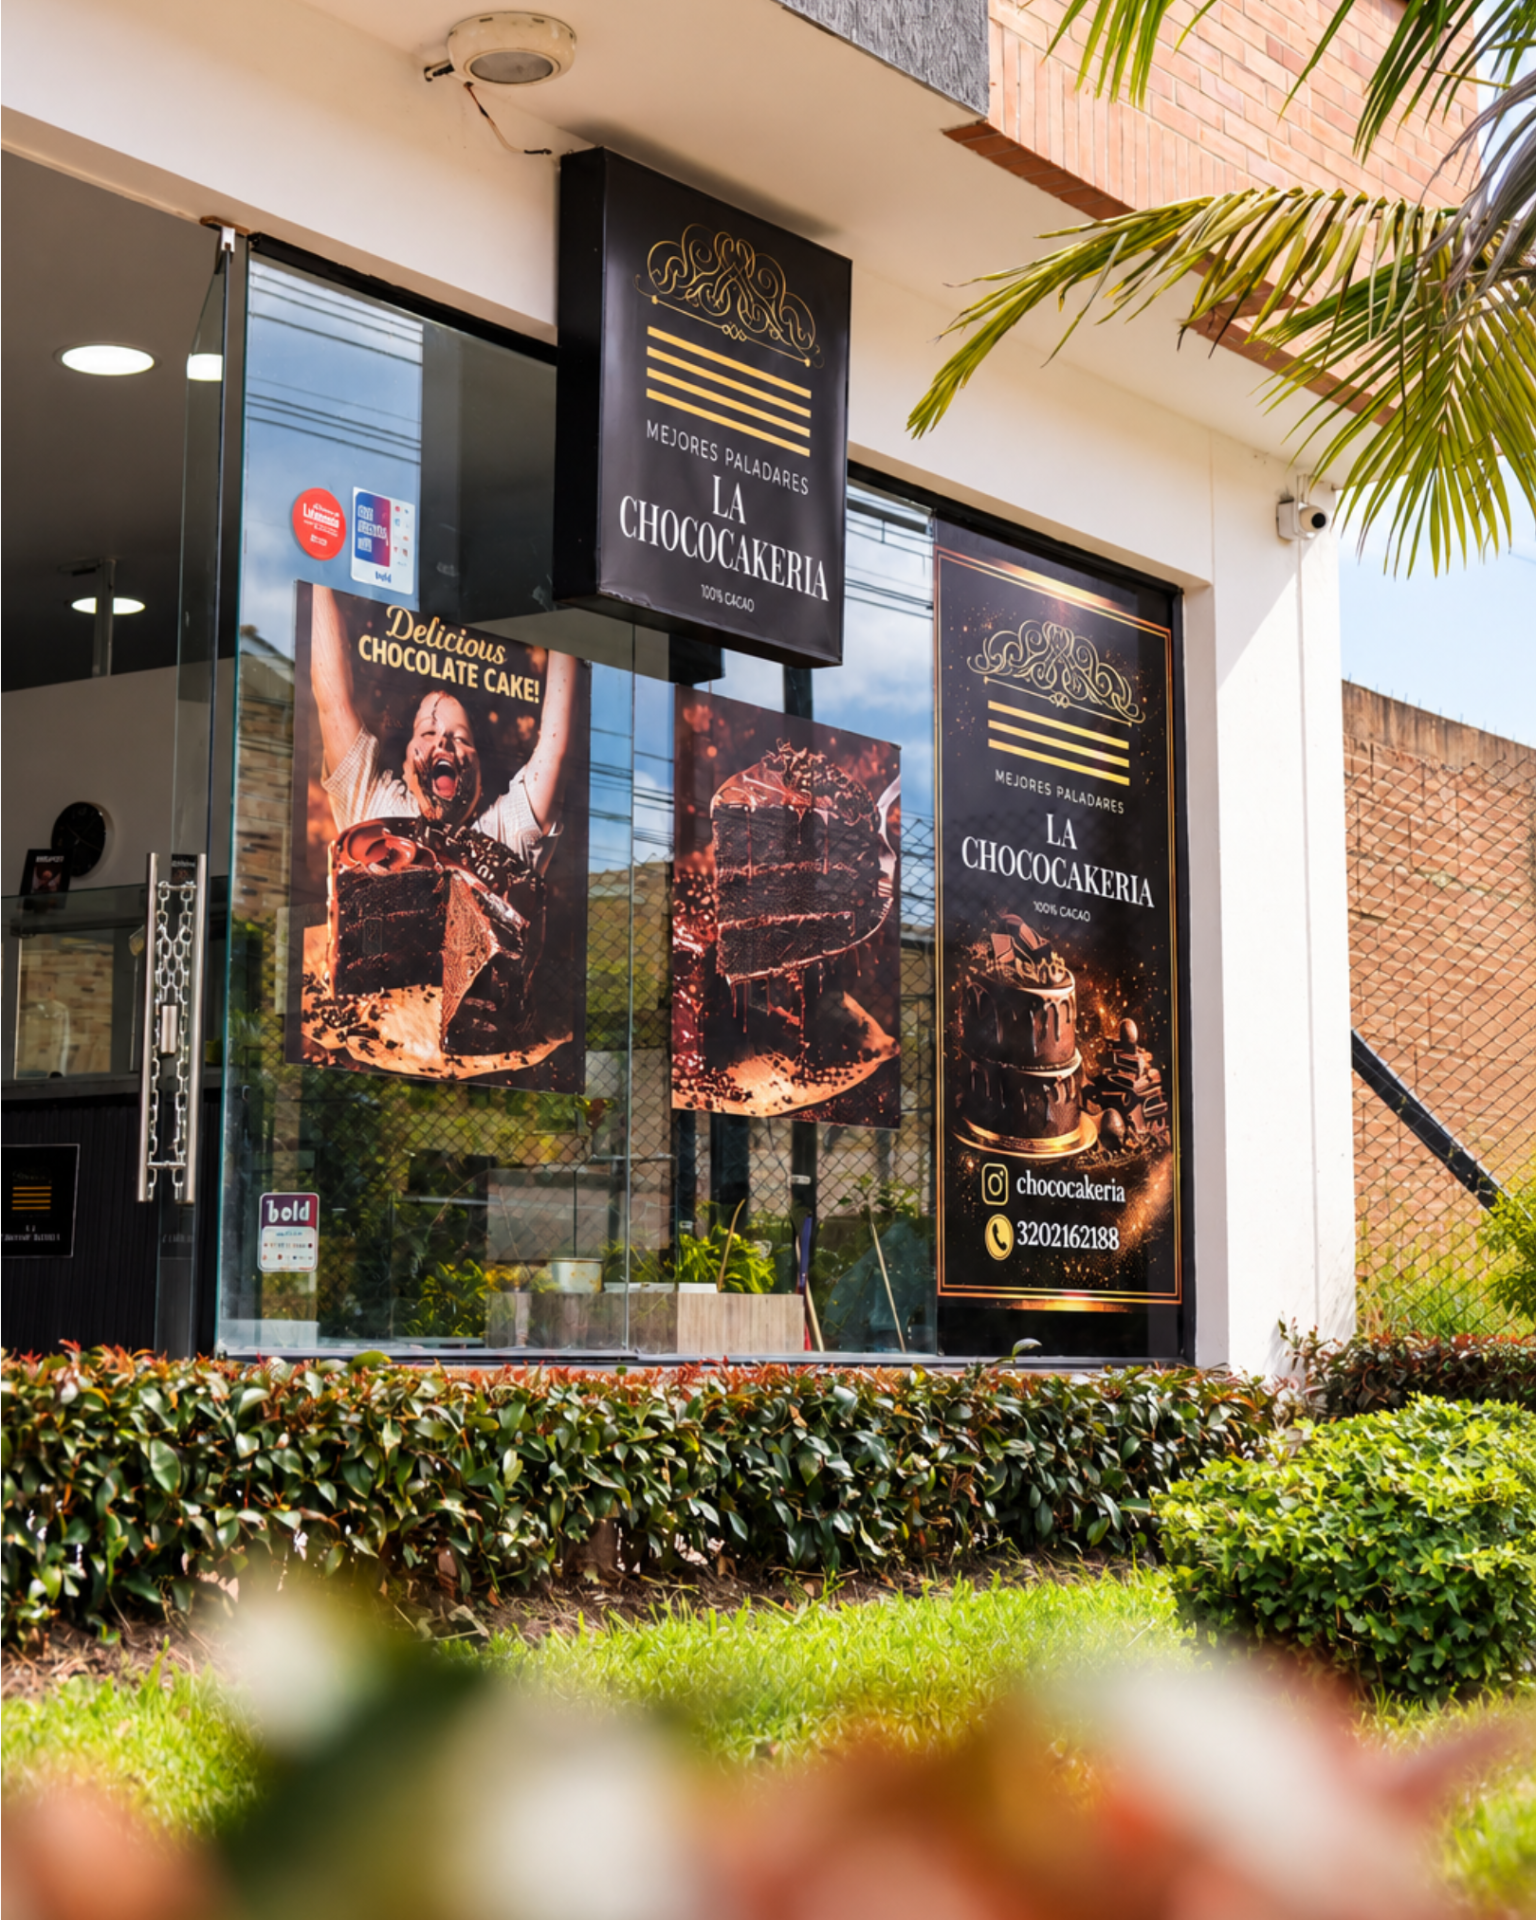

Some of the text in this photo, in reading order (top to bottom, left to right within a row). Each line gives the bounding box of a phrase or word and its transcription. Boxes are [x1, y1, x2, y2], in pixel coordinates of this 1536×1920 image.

[646, 419, 809, 496] MEJORES PALADARES
[712, 474, 747, 525] LA
[619, 495, 830, 602] CHOCOCAKERIA
[701, 584, 755, 612] 100% CACAO
[386, 604, 508, 665] Delicious
[358, 634, 540, 705] CHOCOLATE CAKE!
[994, 769, 1125, 814] MEJORES PALADARES
[1046, 813, 1078, 850] LA
[961, 836, 1155, 909] CHOCOCAKERIA
[1033, 900, 1091, 922] 100% CACAO
[1016, 1169, 1126, 1203] chococakeria
[265, 1199, 310, 1224] bold
[1016, 1220, 1120, 1251] 3202162188
